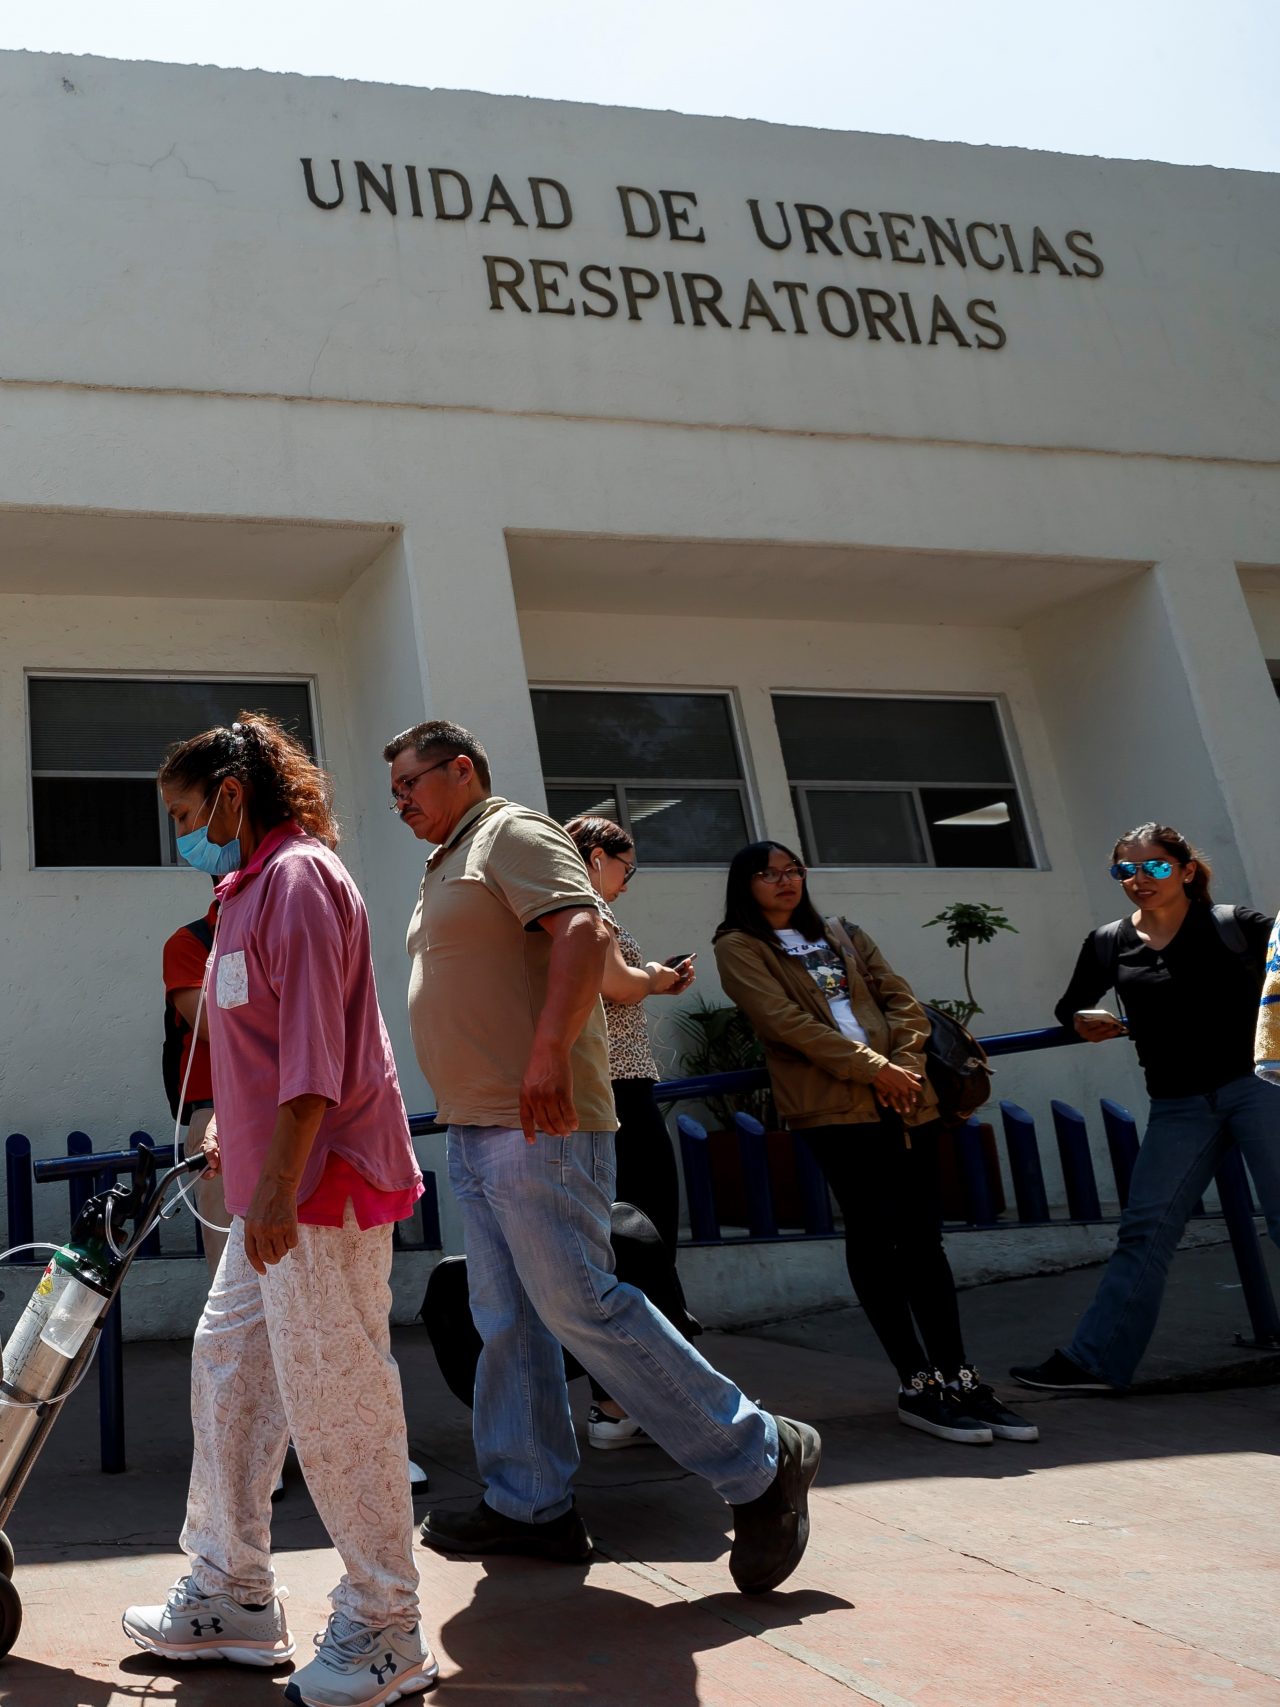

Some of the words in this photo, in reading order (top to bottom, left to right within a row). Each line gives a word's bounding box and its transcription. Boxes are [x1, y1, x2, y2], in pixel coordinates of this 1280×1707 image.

[299, 156, 573, 230] UNIDAD
[616, 184, 707, 243] DE
[747, 198, 1105, 278] URGENCIAS
[482, 254, 1008, 350] RESPIRATORIAS
